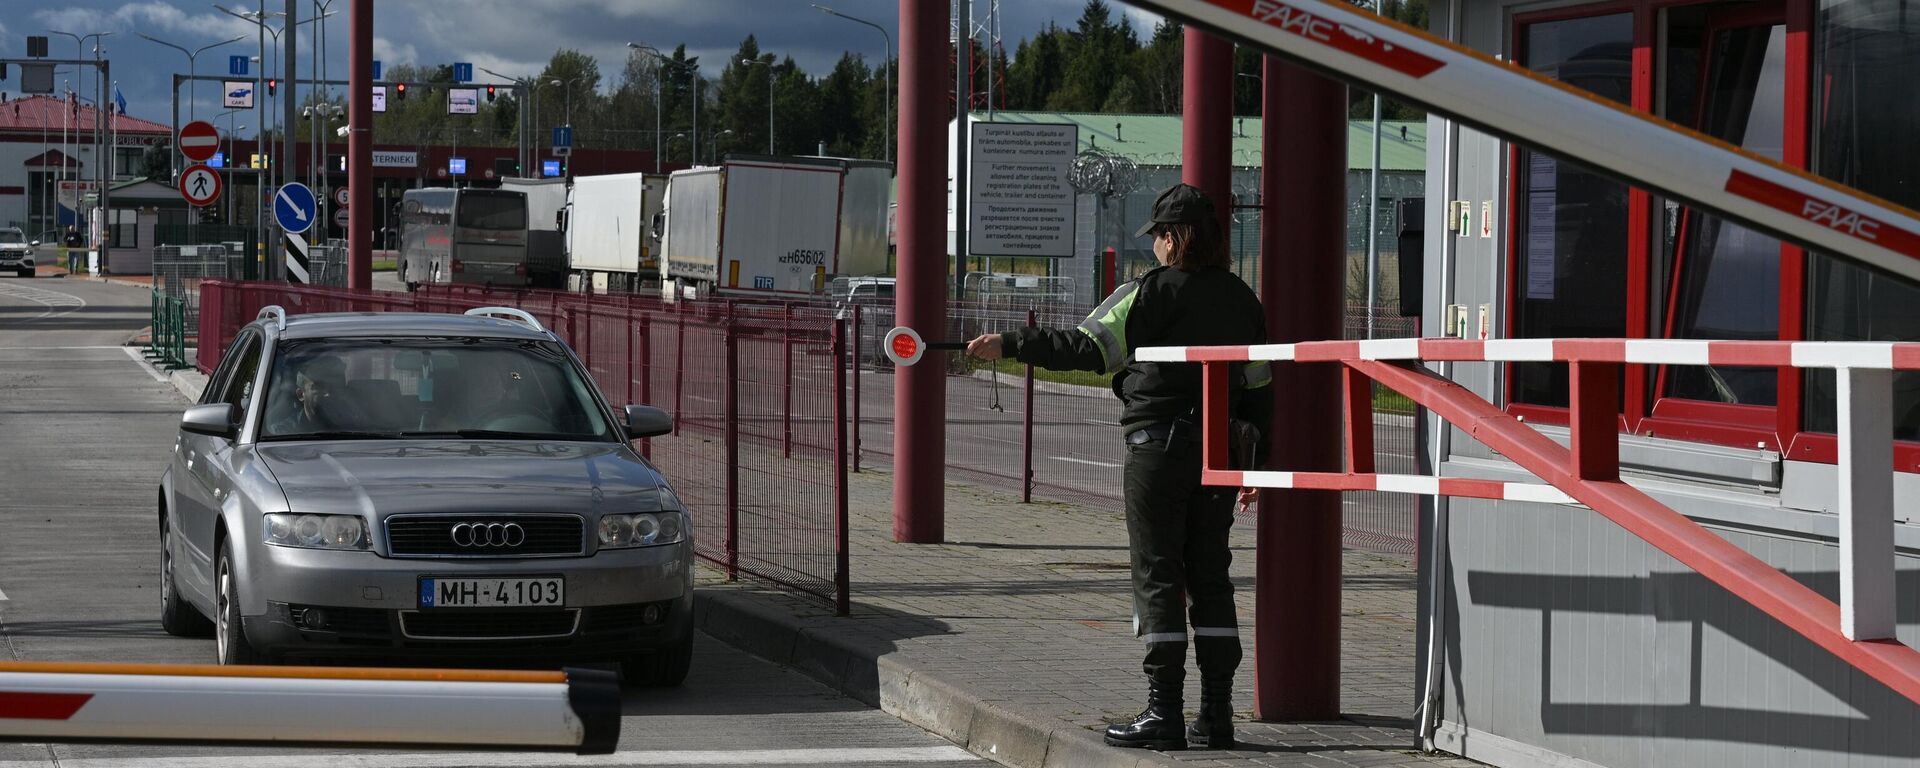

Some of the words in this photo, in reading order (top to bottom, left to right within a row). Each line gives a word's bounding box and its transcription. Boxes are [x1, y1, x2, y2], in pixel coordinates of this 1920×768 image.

[1252, 0, 1333, 41] FAAC
[372, 155, 414, 164] TERNIEKI
[1031, 174, 1057, 182] cleaning
[980, 215, 1020, 223] разрешается
[1802, 200, 1880, 240] FAAC
[756, 278, 773, 289] TIR
[422, 595, 432, 603] LV
[441, 580, 559, 605] MH-4103
